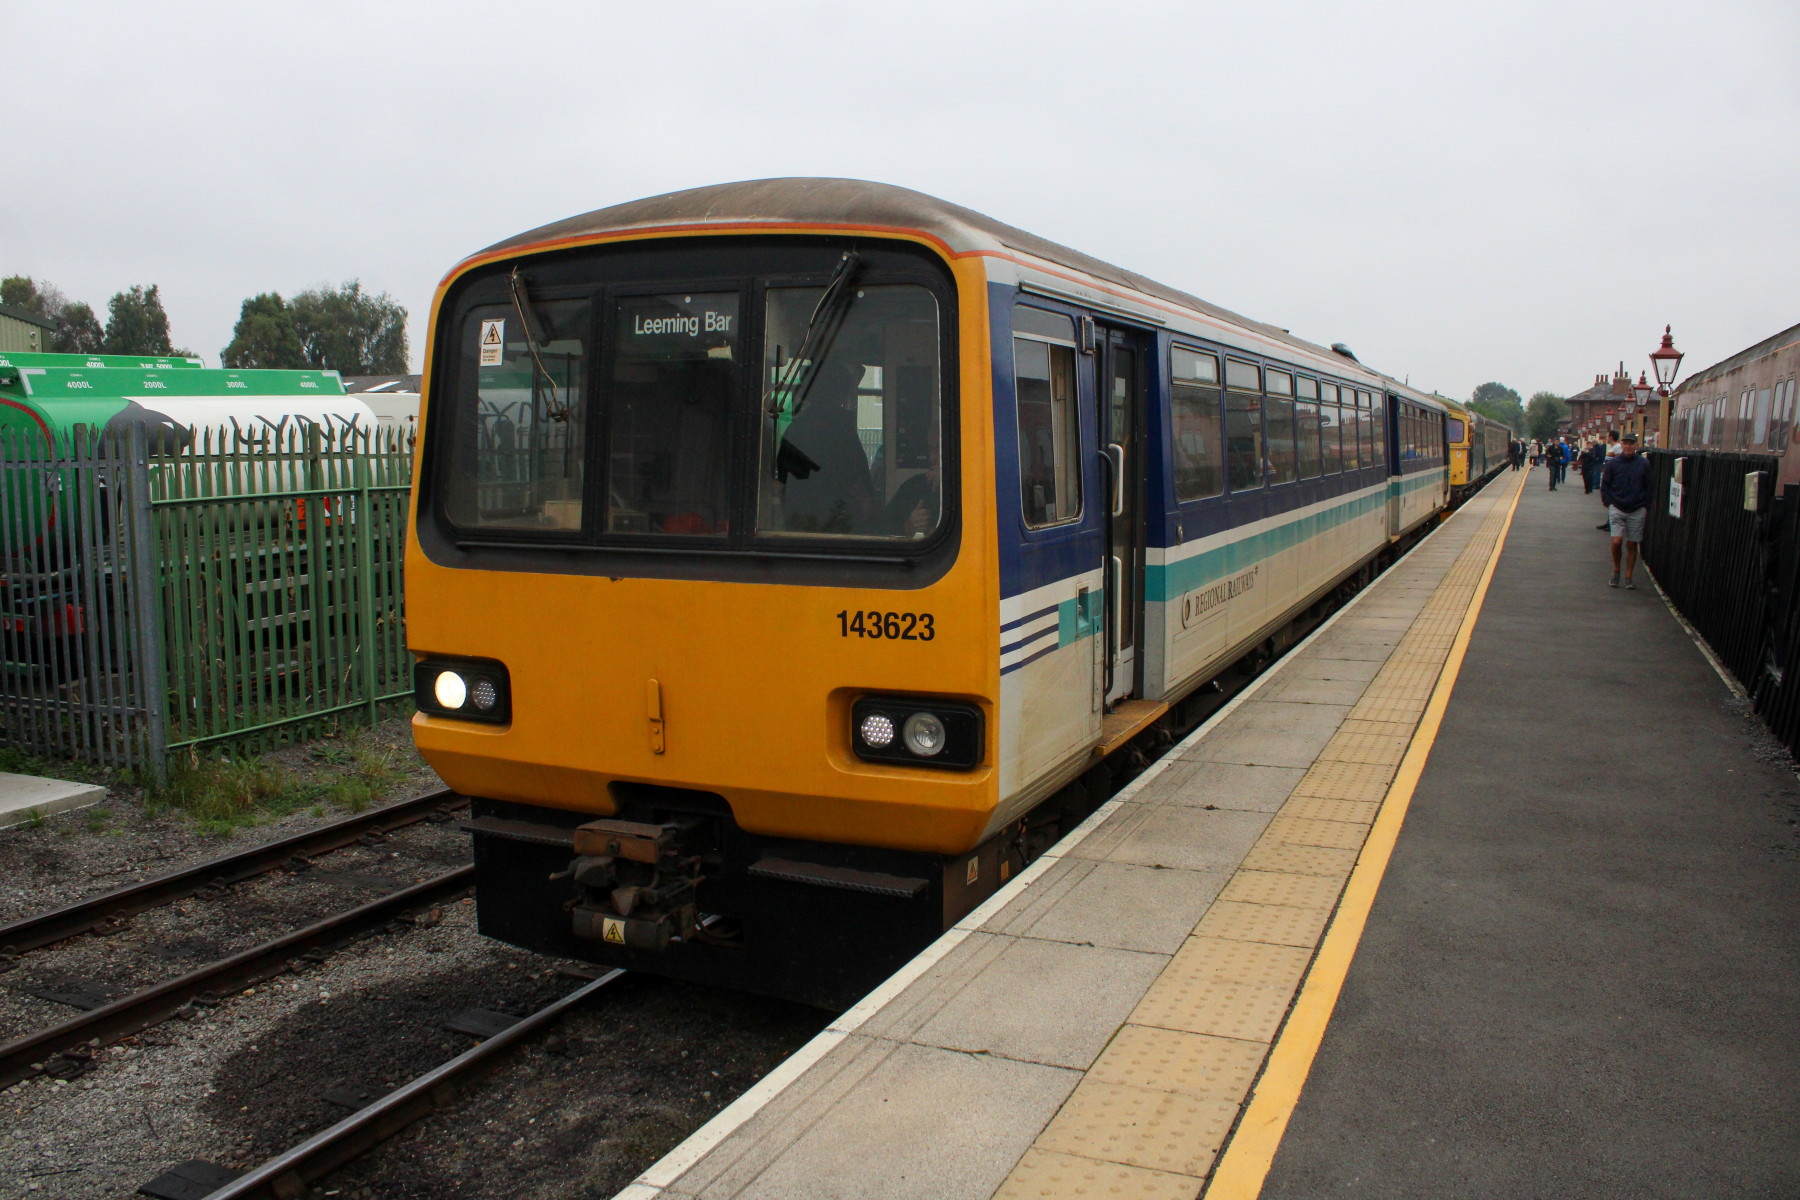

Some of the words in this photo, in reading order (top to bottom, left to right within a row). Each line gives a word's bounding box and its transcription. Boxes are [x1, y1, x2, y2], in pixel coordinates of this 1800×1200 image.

[635, 313, 699, 336] Leeming
[705, 311, 732, 331] Bar
[1195, 583, 1226, 616] REGIONAL
[1227, 571, 1255, 600] RAILWAYS
[837, 610, 935, 641] 143623
